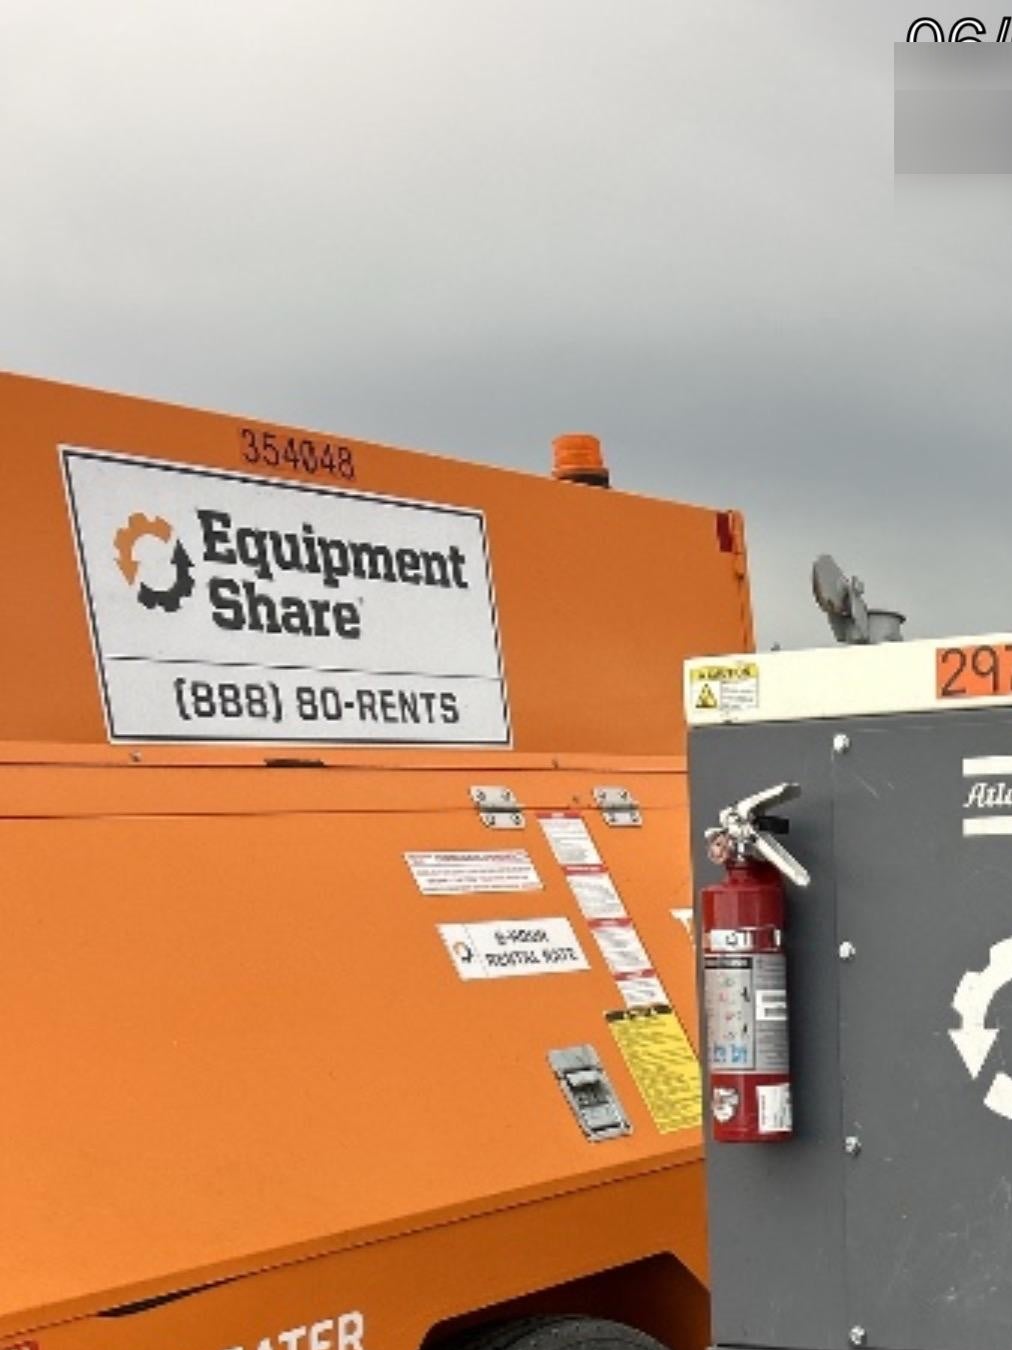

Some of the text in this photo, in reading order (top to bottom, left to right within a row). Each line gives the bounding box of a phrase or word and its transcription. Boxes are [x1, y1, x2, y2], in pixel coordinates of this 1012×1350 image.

[241, 428, 356, 480] 354048
[197, 508, 470, 590] Equipment
[208, 576, 361, 640] Share
[174, 677, 460, 724] (888) 80-RENTS
